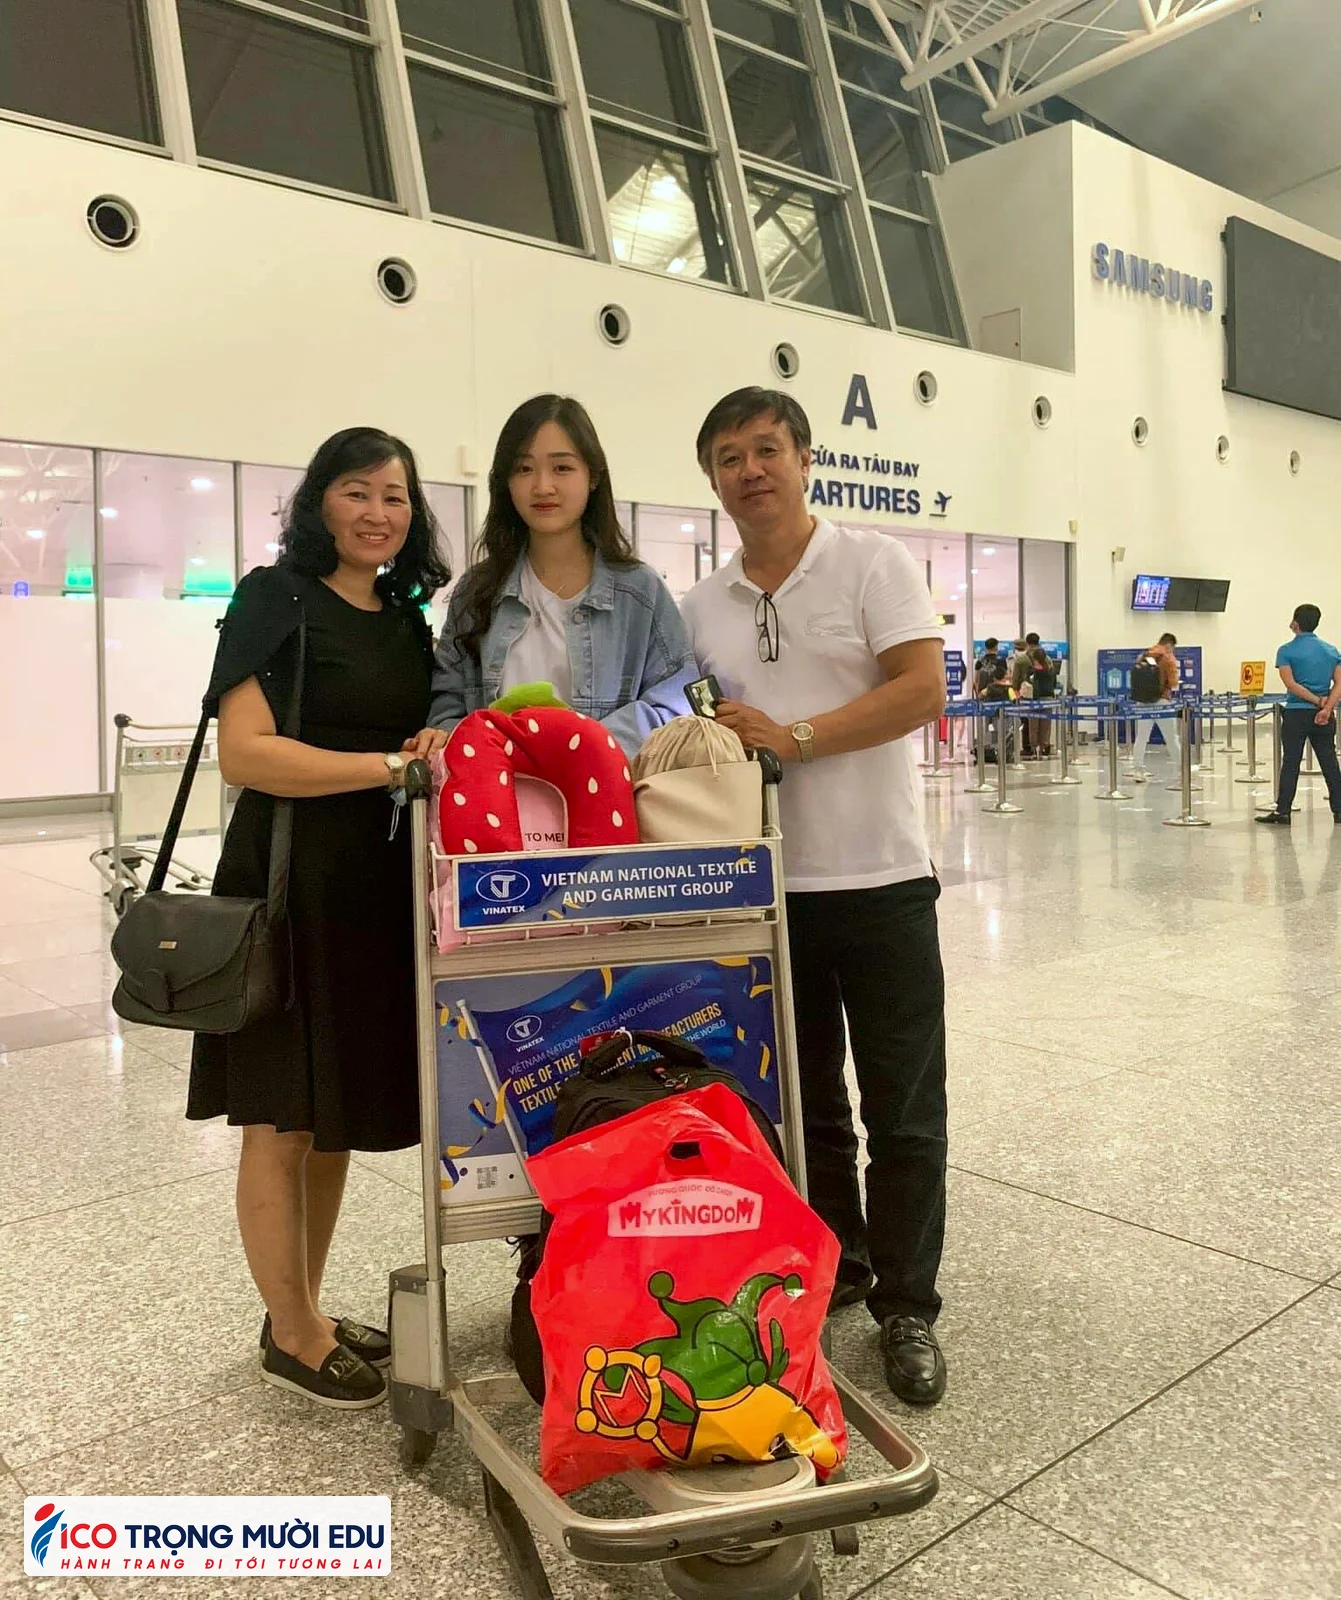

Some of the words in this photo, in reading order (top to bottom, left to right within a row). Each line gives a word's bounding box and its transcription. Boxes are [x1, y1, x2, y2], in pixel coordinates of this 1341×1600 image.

[1090, 242, 1213, 313] SAMSUNG
[841, 373, 877, 430] A
[840, 453, 860, 471] RA
[893, 461, 920, 478] BAY
[810, 478, 921, 514] ARTURES
[524, 832, 542, 842] TO
[541, 870, 614, 887] VIETNAM
[618, 865, 695, 882] NATIONAL
[698, 860, 757, 877] TEXTILE
[562, 889, 597, 905] AND
[601, 884, 677, 901] GARMENT
[681, 880, 734, 896] GROUP
[482, 905, 525, 915] VINATEX
[507, 1051, 546, 1076] VIETNAM
[545, 1033, 588, 1058] NATIONAL
[586, 1015, 619, 1037] TEXTILE
[619, 1006, 637, 1024] AND
[637, 987, 675, 1013] GARMENT
[675, 973, 704, 994] GROUP
[700, 1018, 727, 1037] WORLD
[516, 1036, 544, 1053] VINATEX
[513, 1072, 538, 1096] ONE
[537, 1064, 553, 1083] OF
[554, 1052, 579, 1075] THE
[519, 1081, 562, 1114] TEXTILE
[619, 1197, 755, 1230] MYKINGDOM
